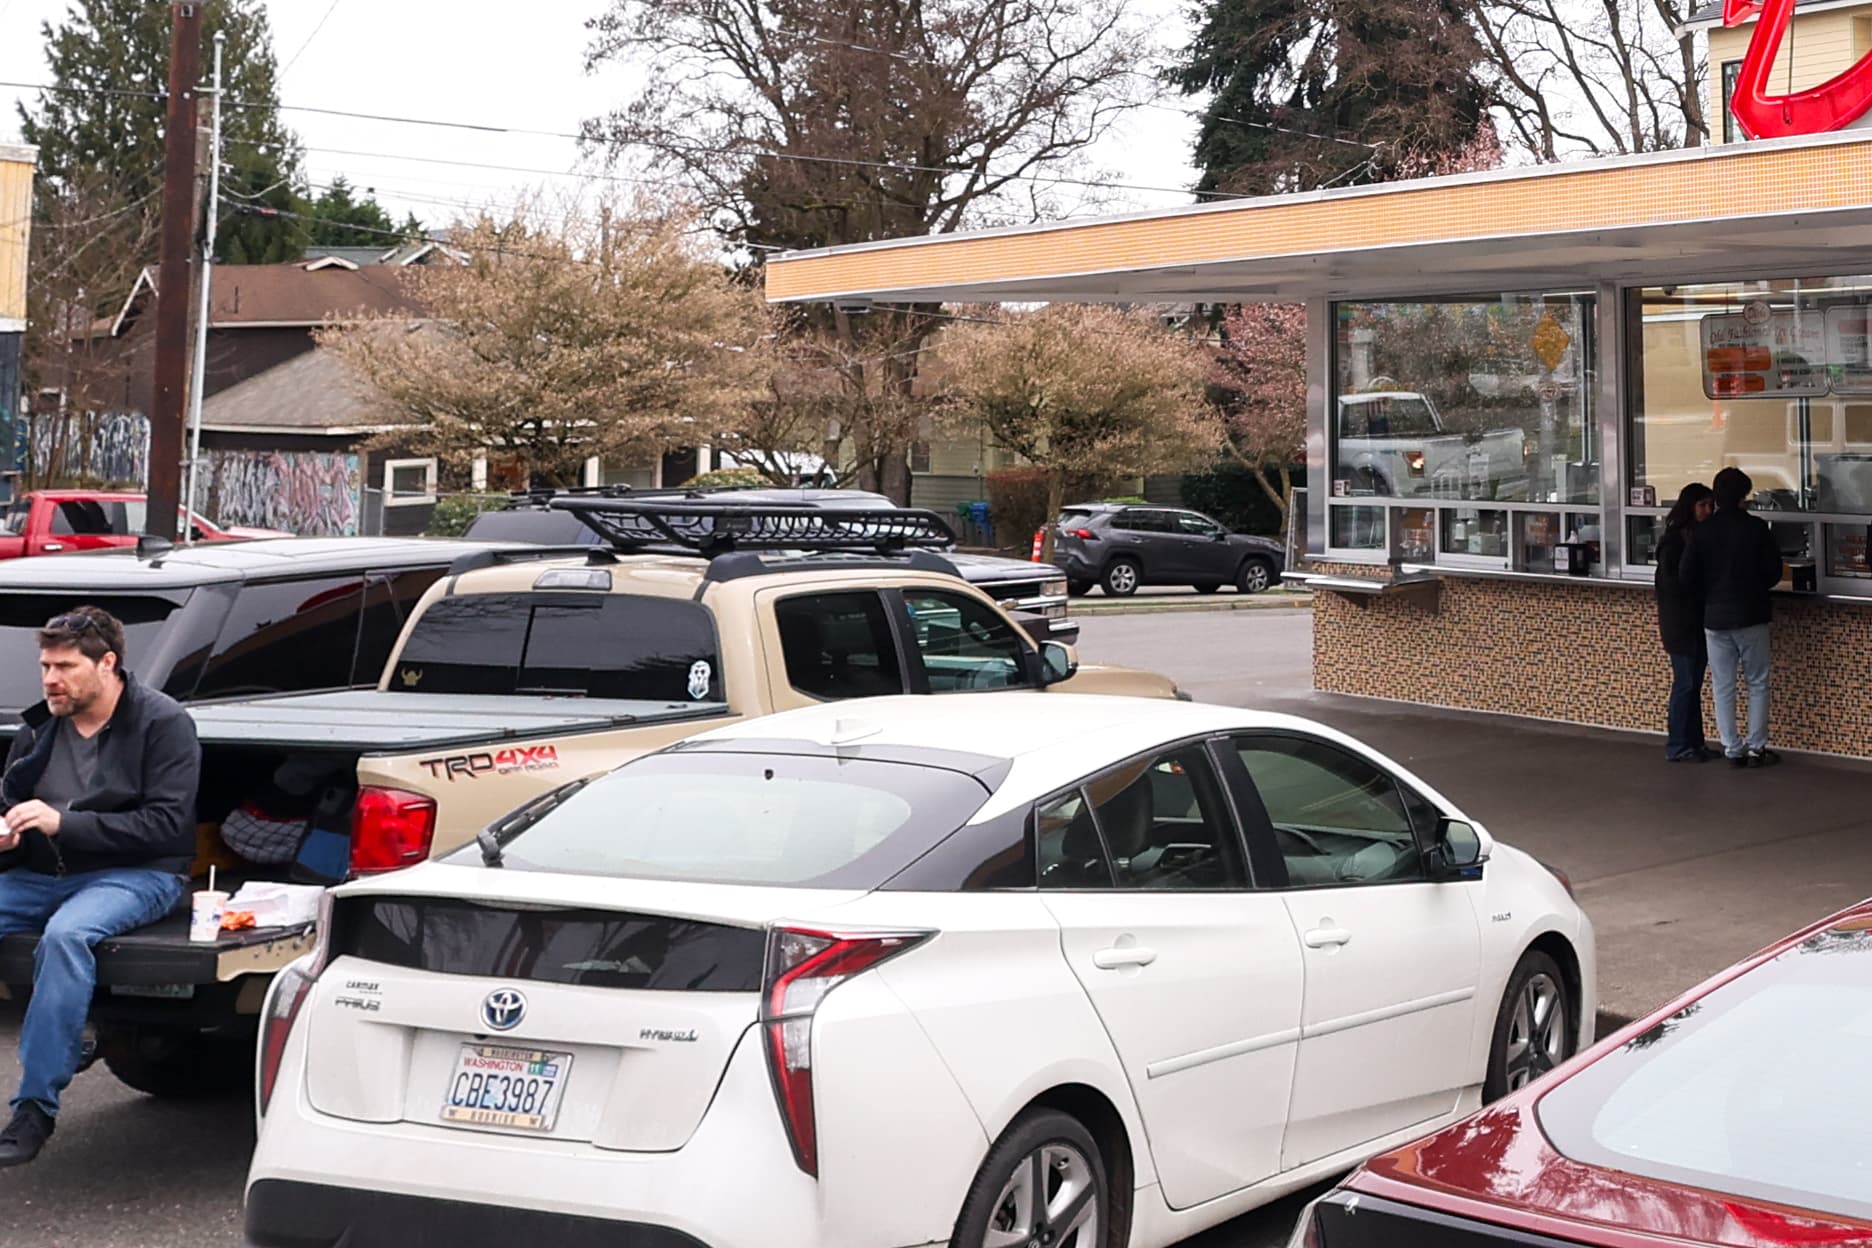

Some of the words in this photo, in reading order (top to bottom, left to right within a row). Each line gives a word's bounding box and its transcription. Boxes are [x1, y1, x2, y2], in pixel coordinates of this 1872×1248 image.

[419, 753, 494, 782] TRD
[495, 745, 558, 765] 4X4
[463, 1057, 524, 1073] WASHINGTON
[451, 1071, 554, 1116] CBE3987
